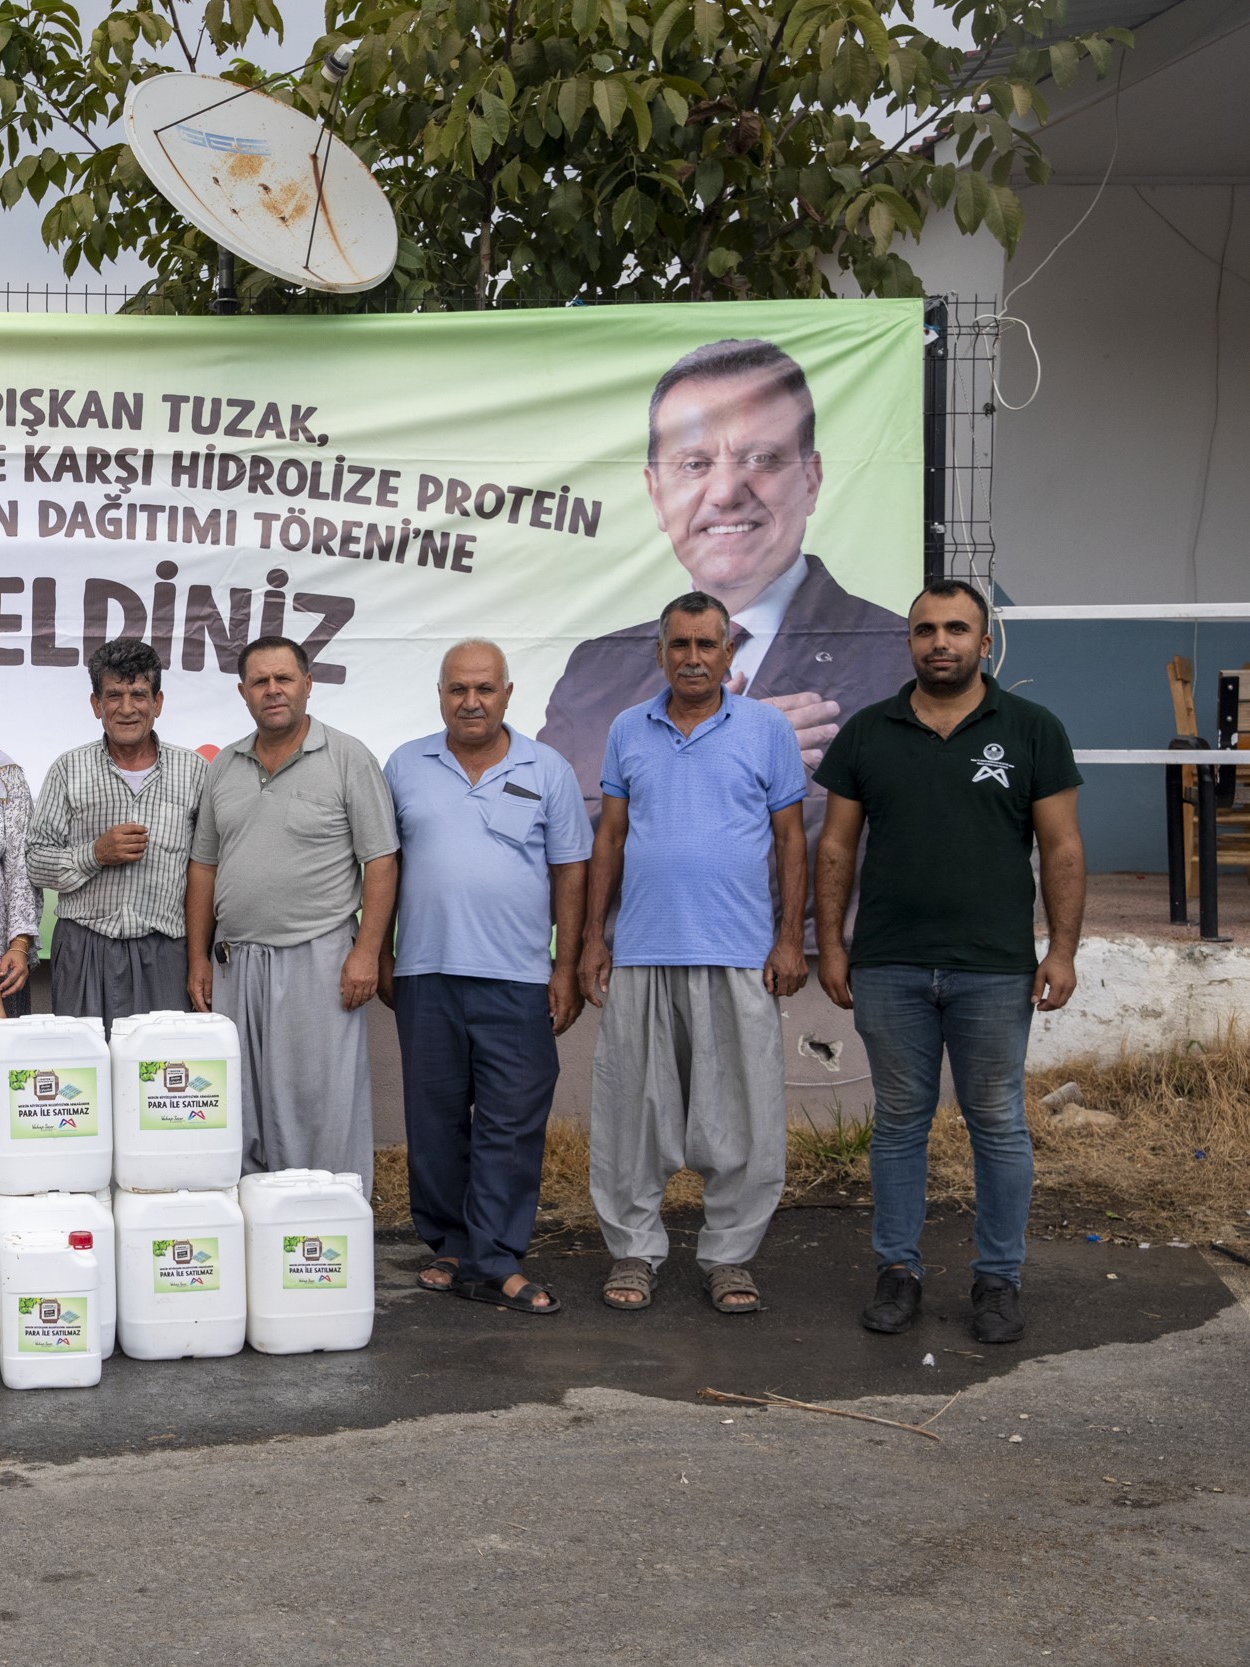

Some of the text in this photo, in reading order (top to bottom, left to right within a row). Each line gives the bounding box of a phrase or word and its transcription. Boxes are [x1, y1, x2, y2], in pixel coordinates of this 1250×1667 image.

[161, 394, 330, 447] TUZAK,
[23, 444, 154, 495] KARŞI
[171, 443, 402, 509] HİDROLİZE
[416, 474, 603, 538] PROTEİN
[37, 493, 237, 548] DAĞITIMI
[253, 507, 478, 575] TÖRENİ'NE
[40, 1108, 50, 1116] İLE
[170, 1100, 180, 1108] İLE
